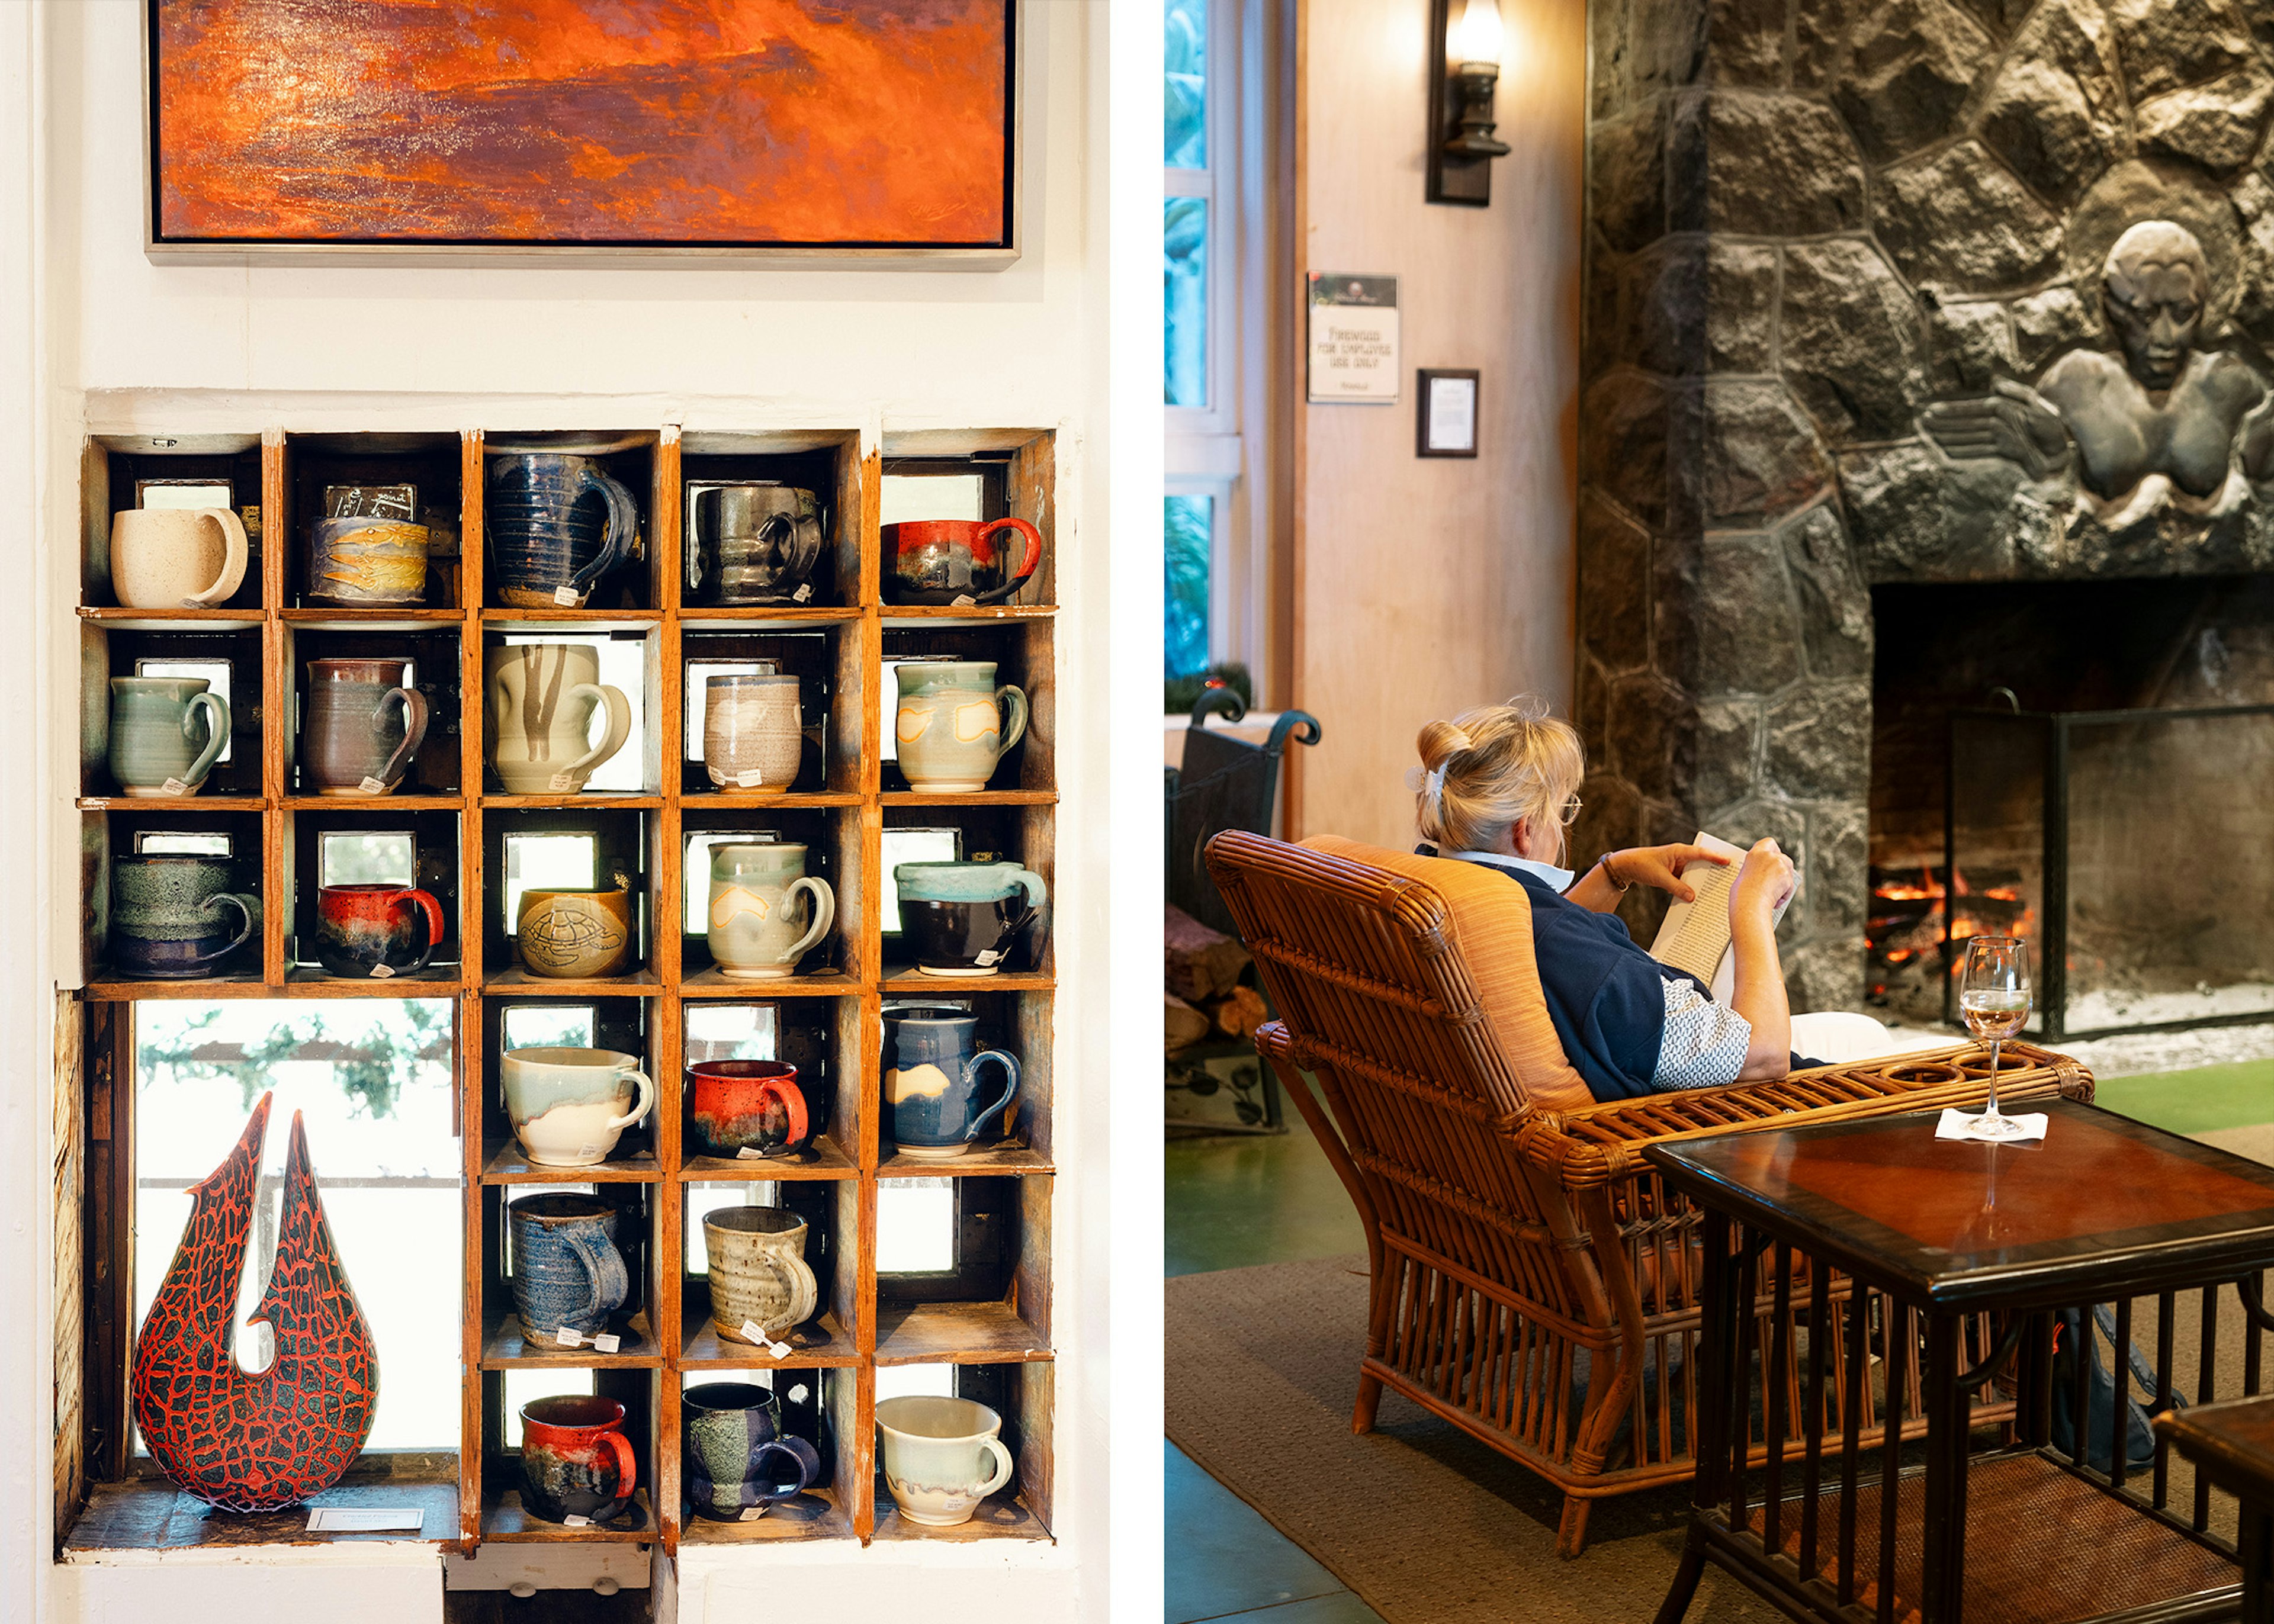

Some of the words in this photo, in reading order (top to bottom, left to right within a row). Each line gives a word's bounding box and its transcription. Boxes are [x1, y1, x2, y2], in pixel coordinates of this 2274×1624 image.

[1317, 343, 1335, 355] FOR
[1329, 356, 1348, 368] USE
[1353, 356, 1378, 369] ONLY
